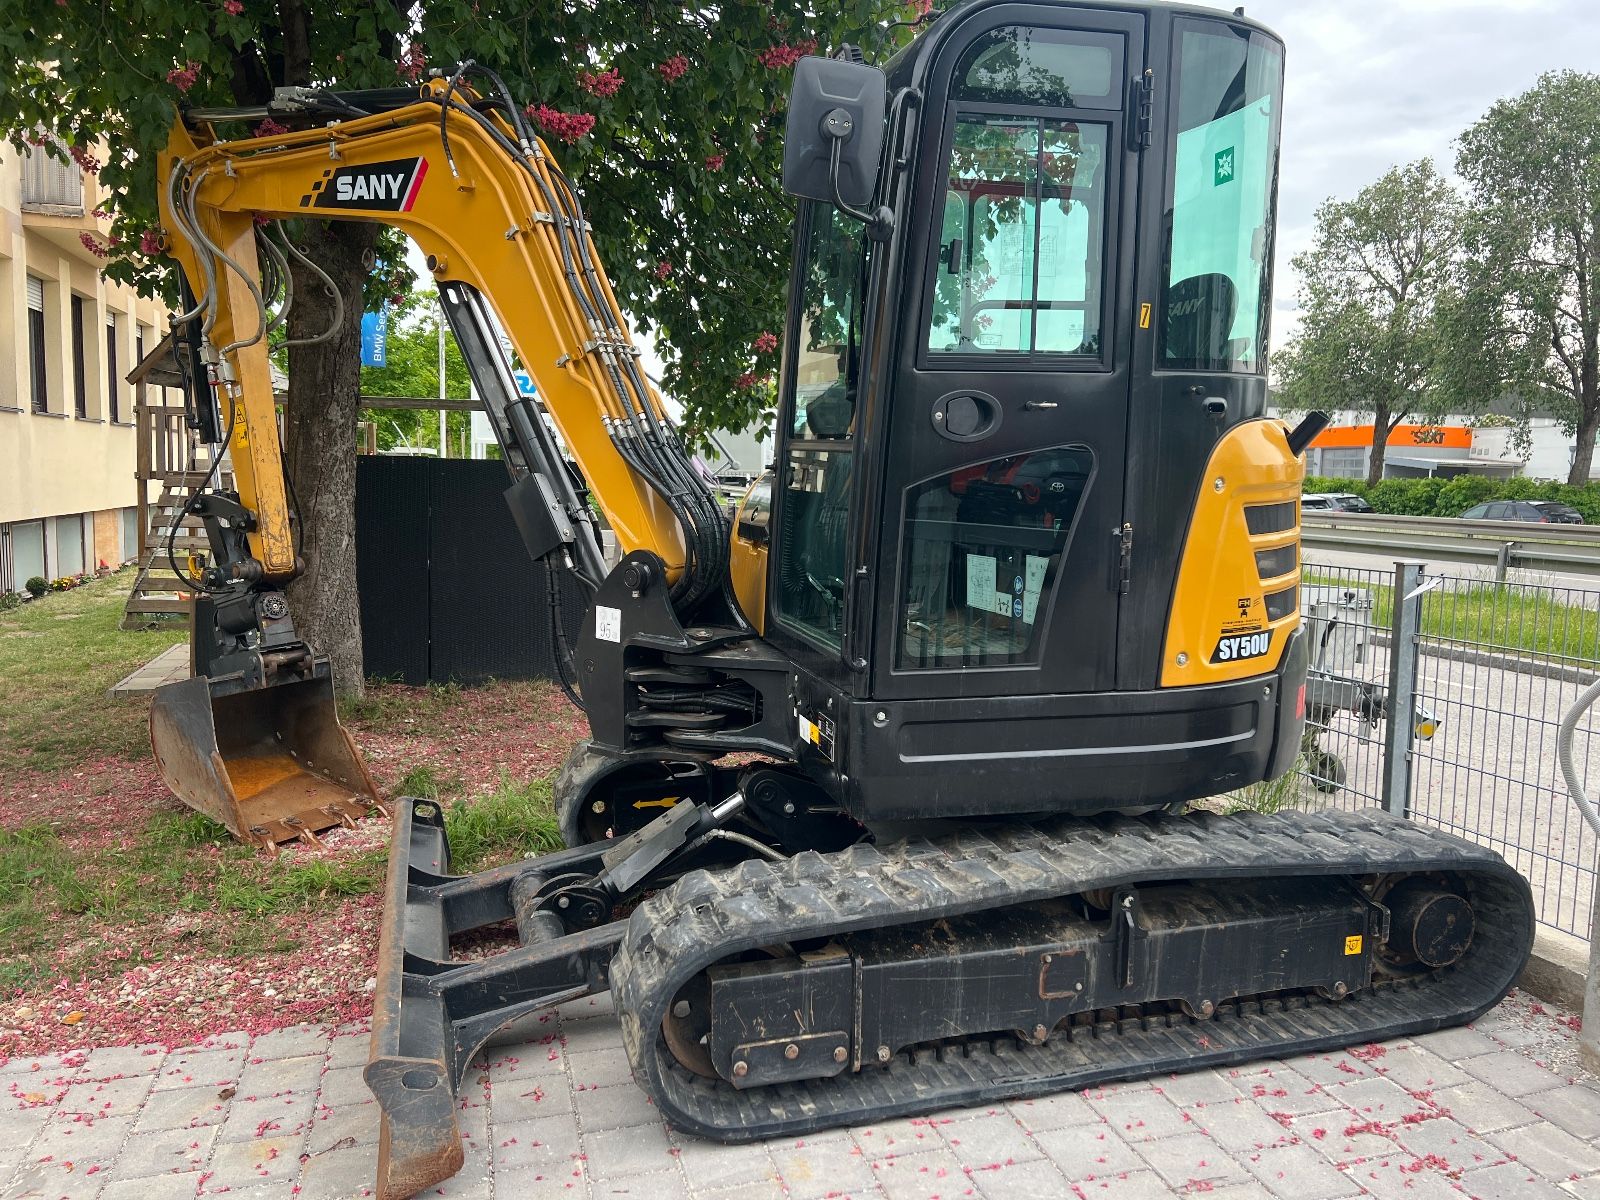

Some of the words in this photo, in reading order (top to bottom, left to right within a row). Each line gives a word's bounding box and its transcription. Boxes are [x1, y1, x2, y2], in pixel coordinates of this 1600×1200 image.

[337, 174, 404, 201] SANY
[373, 334, 384, 362] BMW
[1219, 632, 1269, 660] SY50U
